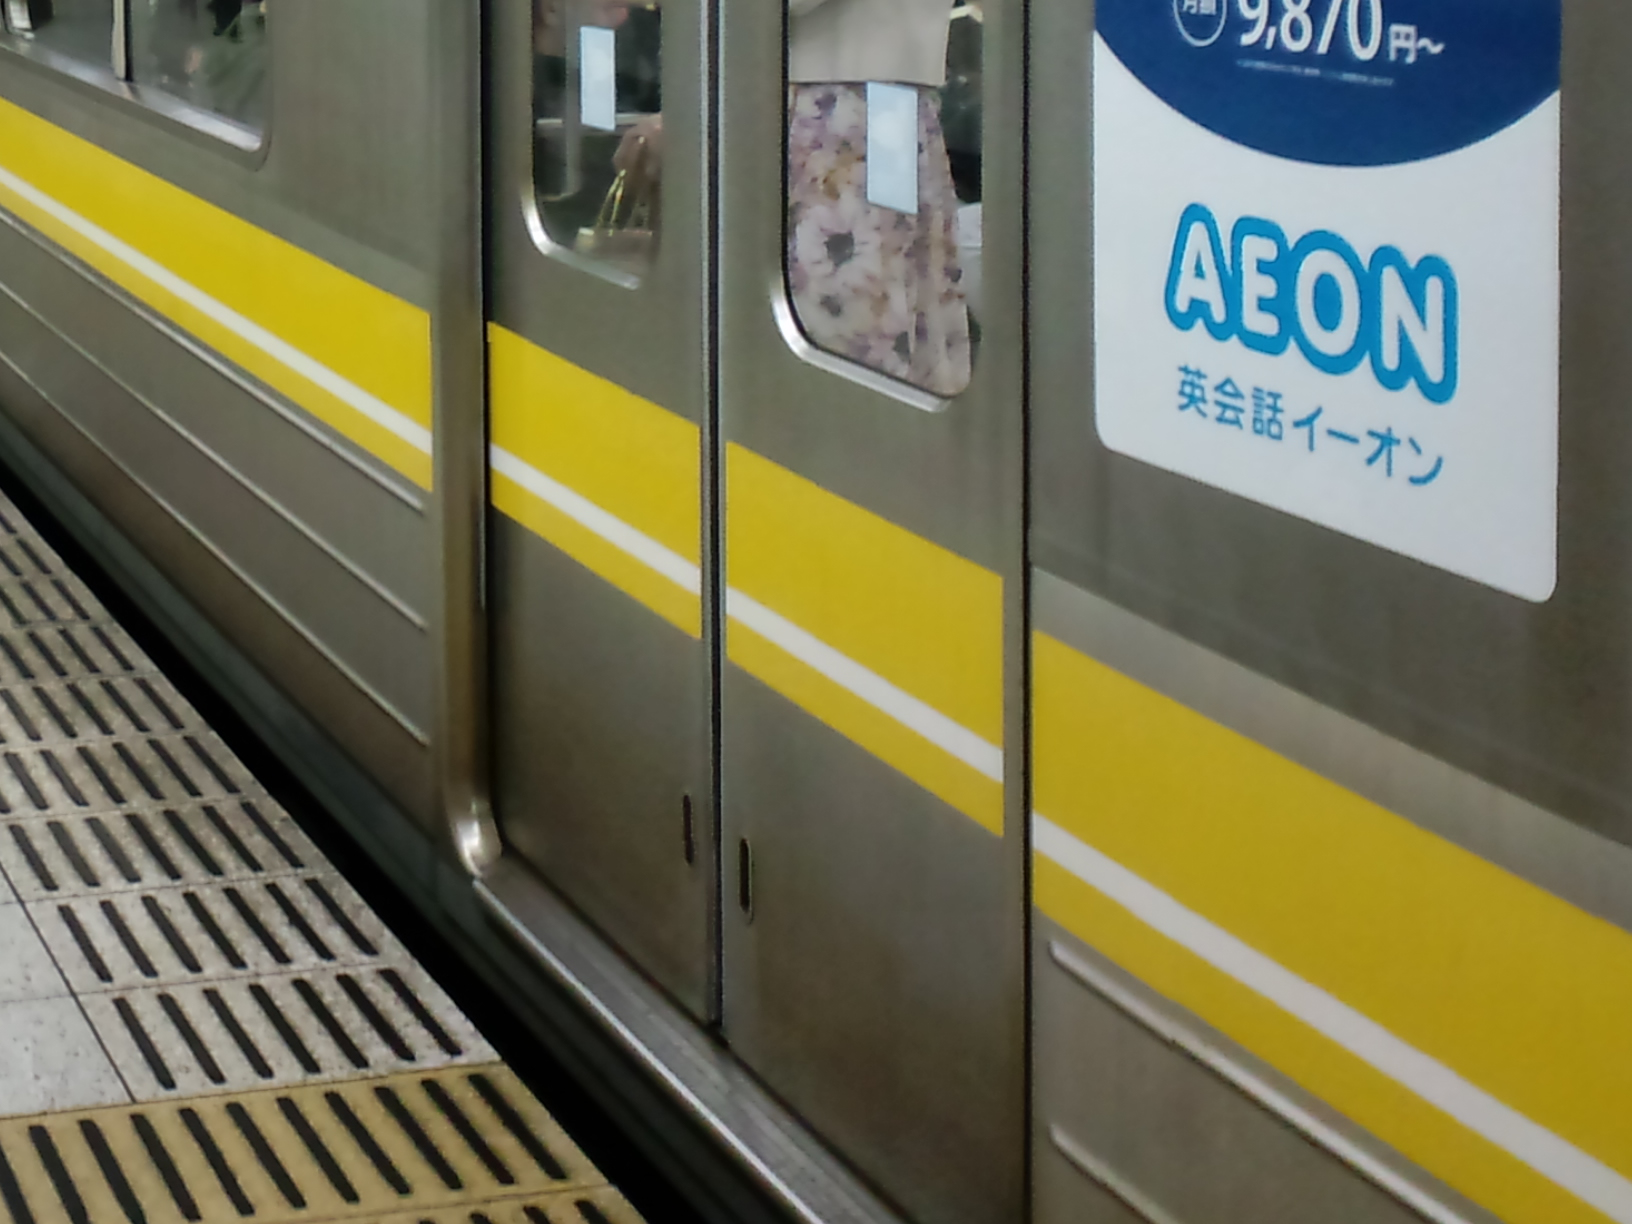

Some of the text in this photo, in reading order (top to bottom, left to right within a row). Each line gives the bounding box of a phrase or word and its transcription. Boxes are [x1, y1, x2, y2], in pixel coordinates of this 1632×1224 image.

[1165, 203, 1459, 403] AEON
[1176, 365, 1444, 486] 英会話イーオン
